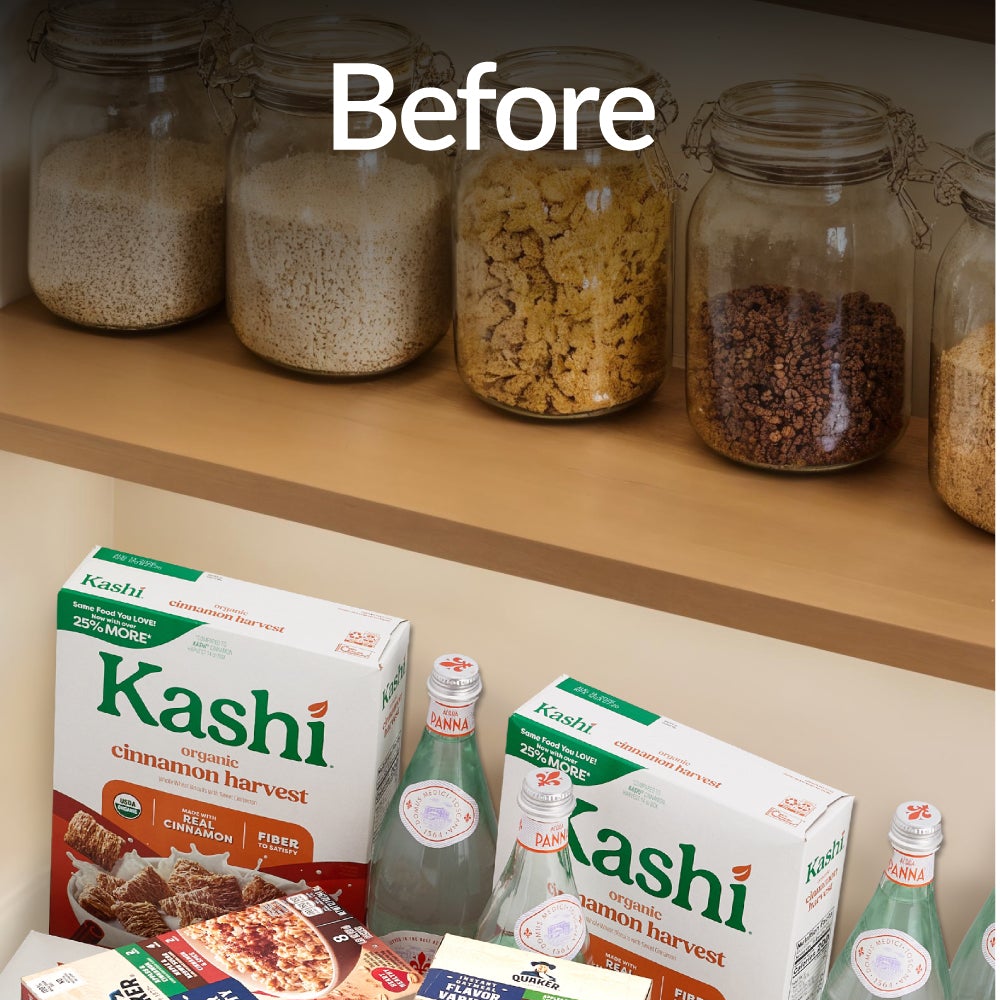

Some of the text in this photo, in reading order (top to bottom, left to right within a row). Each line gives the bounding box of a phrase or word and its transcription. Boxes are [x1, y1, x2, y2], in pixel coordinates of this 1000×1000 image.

[80, 573, 145, 599] Kashi
[73, 600, 157, 627] Same Food You LOVE!
[73, 614, 104, 633] 25%
[91, 612, 137, 629] Now with over
[169, 599, 286, 634] cinnamon harvest
[97, 650, 333, 769] Kashi
[430, 711, 470, 732] PANNA
[533, 701, 597, 735] Kashi
[181, 746, 239, 769] organic
[520, 727, 598, 766] Same Food You LOVE!
[520, 741, 548, 765] 25%
[111, 743, 220, 785] cinnamon
[224, 769, 309, 805] harvest
[613, 739, 724, 790] cinnamon harvest
[181, 807, 217, 822] MADE WITH
[183, 814, 216, 831] REAL
[163, 819, 234, 845] CINNAMON
[257, 831, 300, 850] FIBER
[535, 830, 567, 848] PANN
[257, 842, 299, 857] TO SATISFY
[805, 830, 846, 885] Kashi
[888, 859, 925, 881] PANNA
[608, 890, 663, 921] organic
[646, 921, 727, 968] harvest
[512, 974, 561, 991] QUAKER
